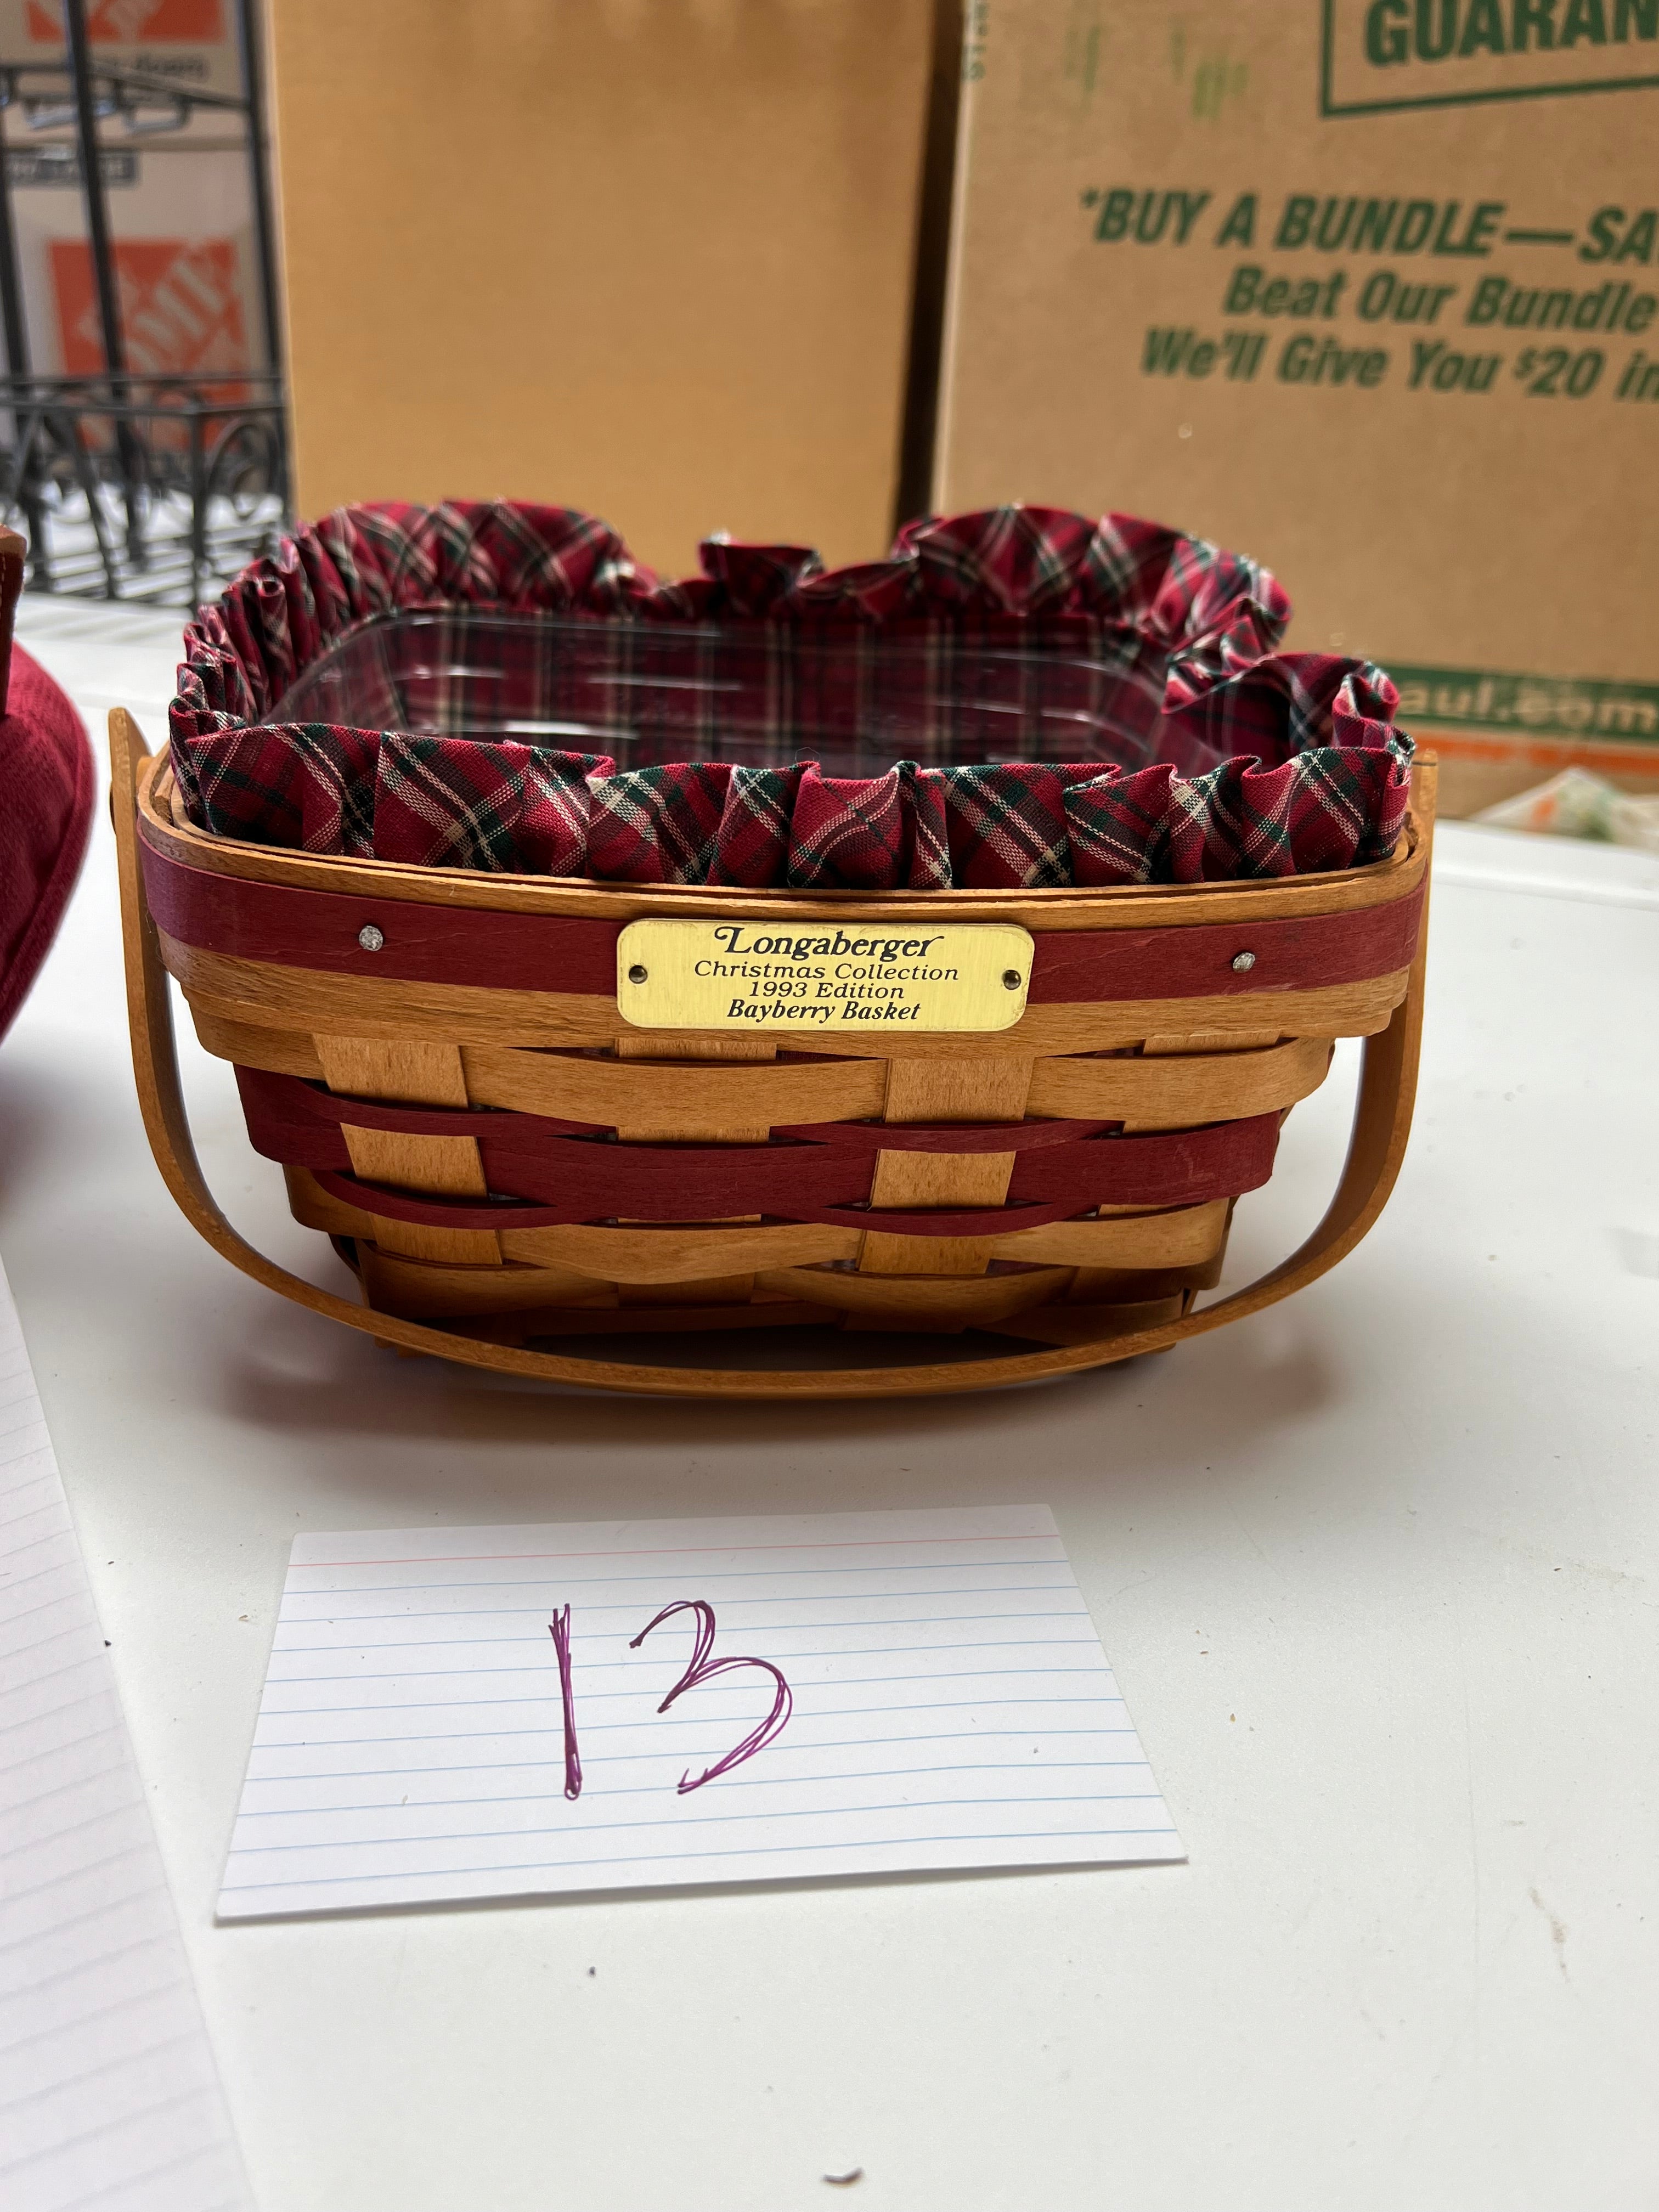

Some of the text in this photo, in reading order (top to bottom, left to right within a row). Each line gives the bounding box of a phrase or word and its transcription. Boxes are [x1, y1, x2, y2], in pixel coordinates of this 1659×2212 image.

[1216, 193, 1258, 249] A
[1223, 265, 1656, 336] Beat Our Bundle
[1143, 328, 1268, 381] We'll
[1278, 334, 1389, 388] Give
[1409, 340, 1502, 393] You
[1516, 347, 1605, 398] $20
[714, 926, 945, 962] Longaberger
[695, 960, 959, 980] Christmas Collection
[749, 981, 904, 999] 1993 Edition
[727, 999, 921, 1023] Bayberry Basket
[549, 1600, 792, 1801] 13
